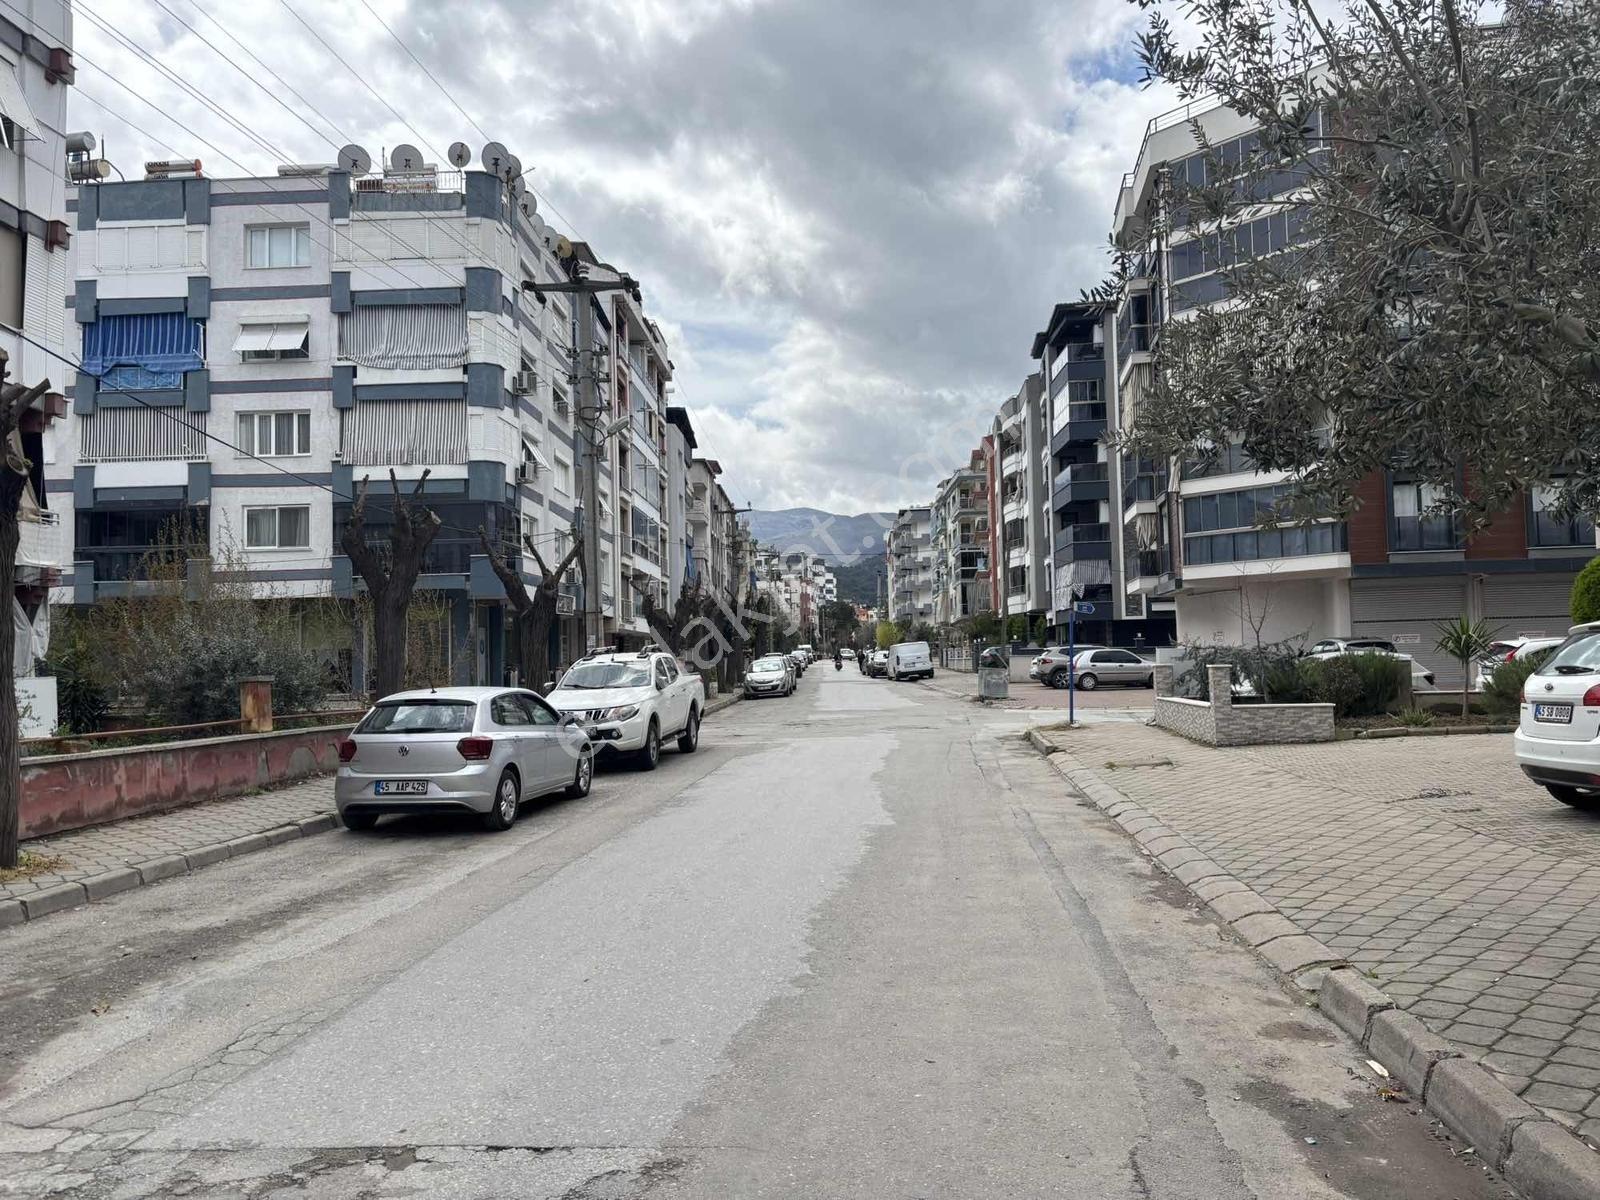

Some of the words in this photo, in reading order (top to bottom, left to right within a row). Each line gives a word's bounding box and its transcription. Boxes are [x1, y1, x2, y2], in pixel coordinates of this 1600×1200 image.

[380, 782, 390, 791] 45
[396, 782, 410, 791] AAP
[411, 782, 426, 791] 429
